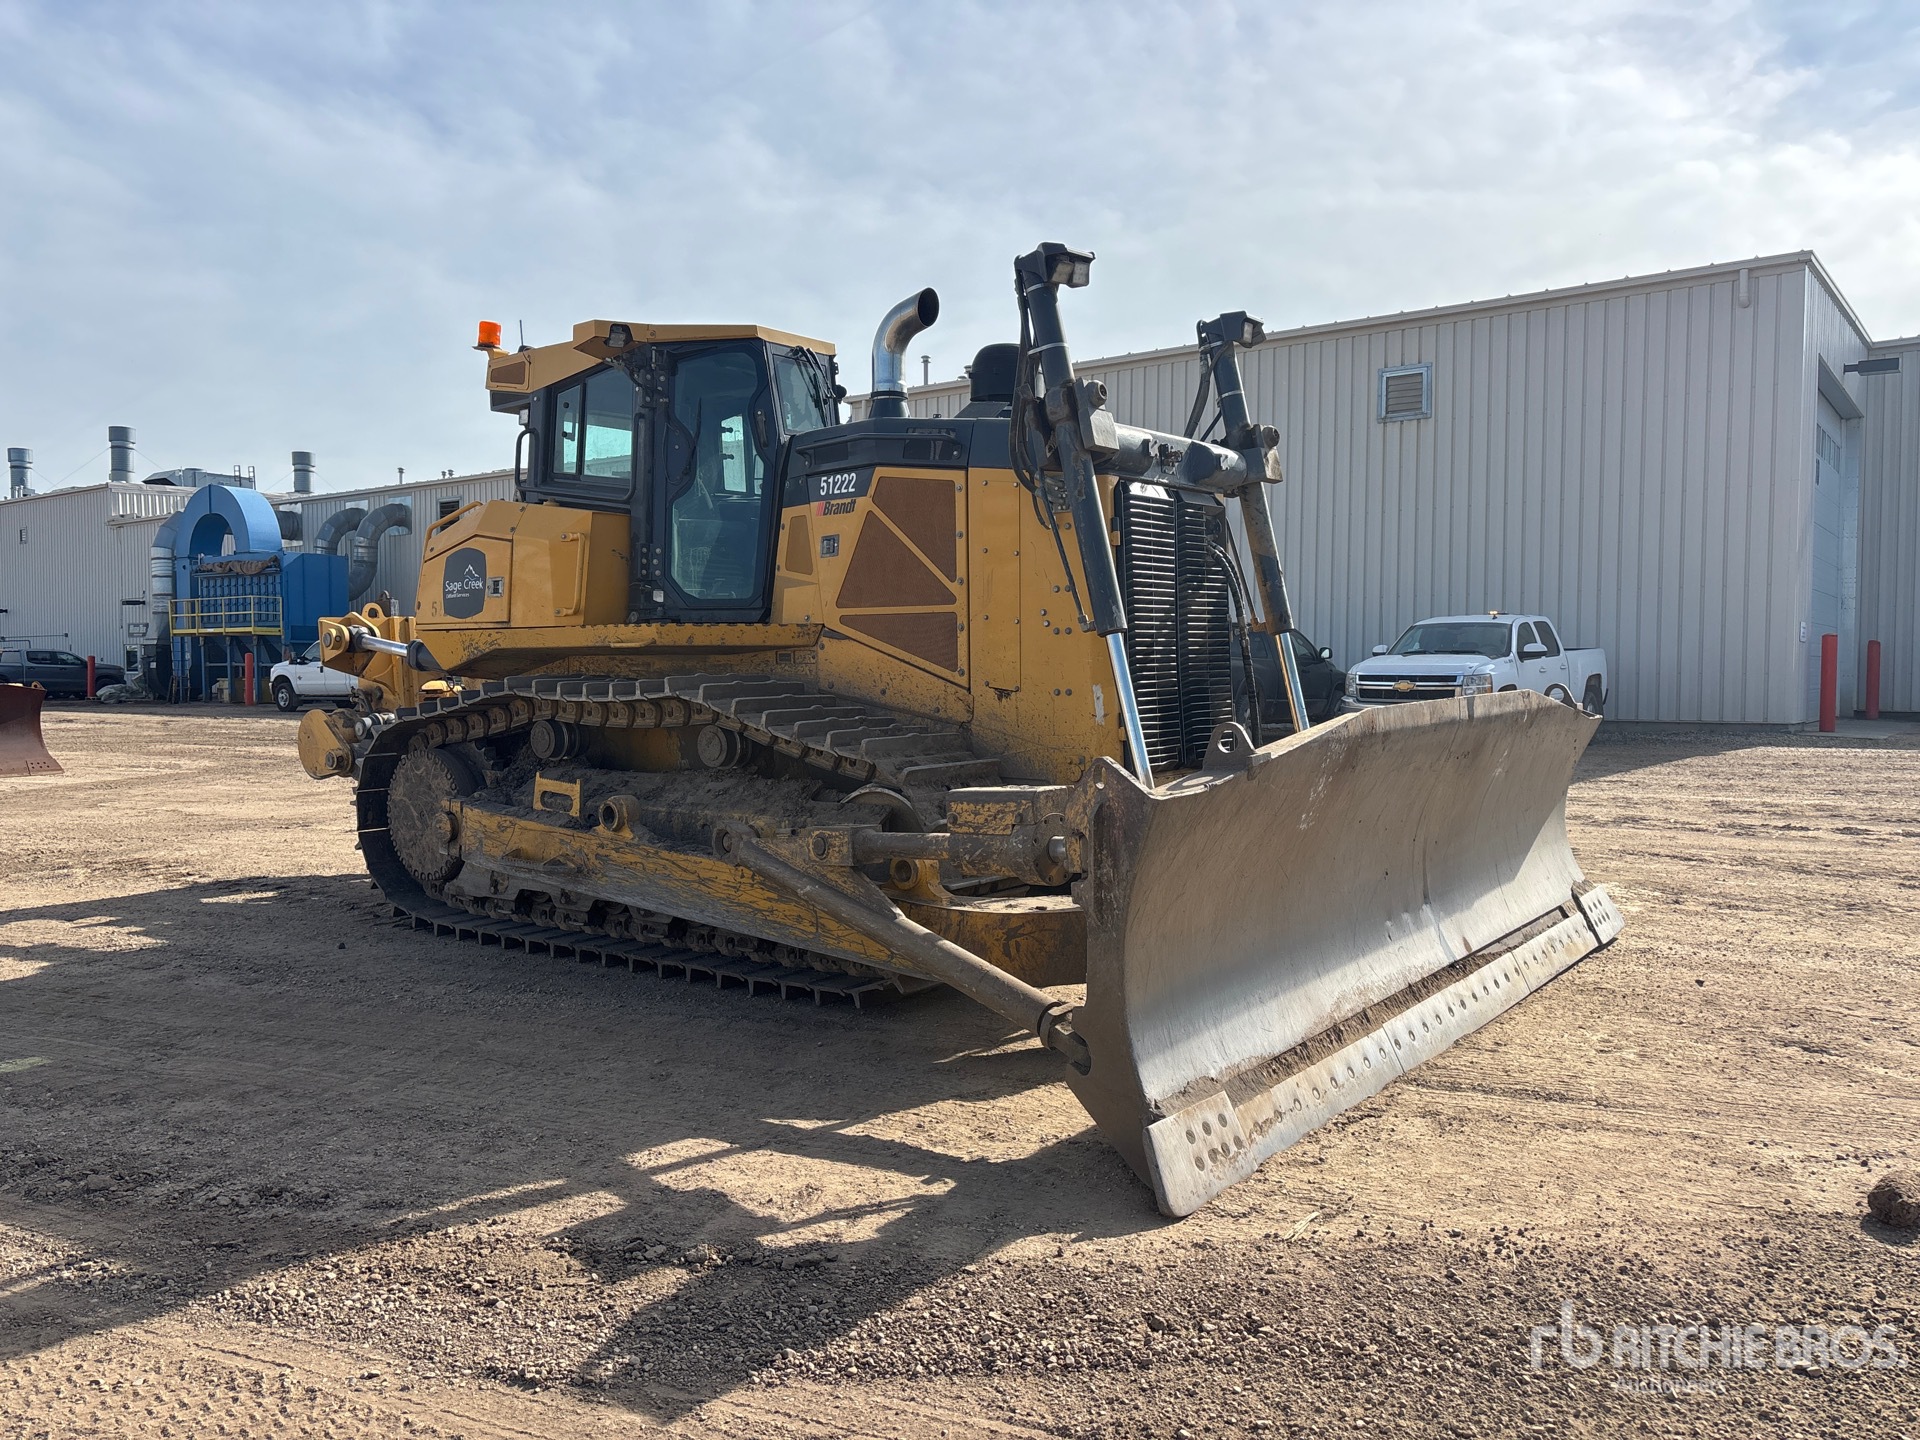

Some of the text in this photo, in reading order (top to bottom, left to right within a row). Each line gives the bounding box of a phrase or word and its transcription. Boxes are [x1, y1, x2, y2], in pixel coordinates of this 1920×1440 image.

[820, 473, 856, 496] 51222
[823, 499, 856, 516] Brandt
[445, 578, 484, 593] Sage Creek
